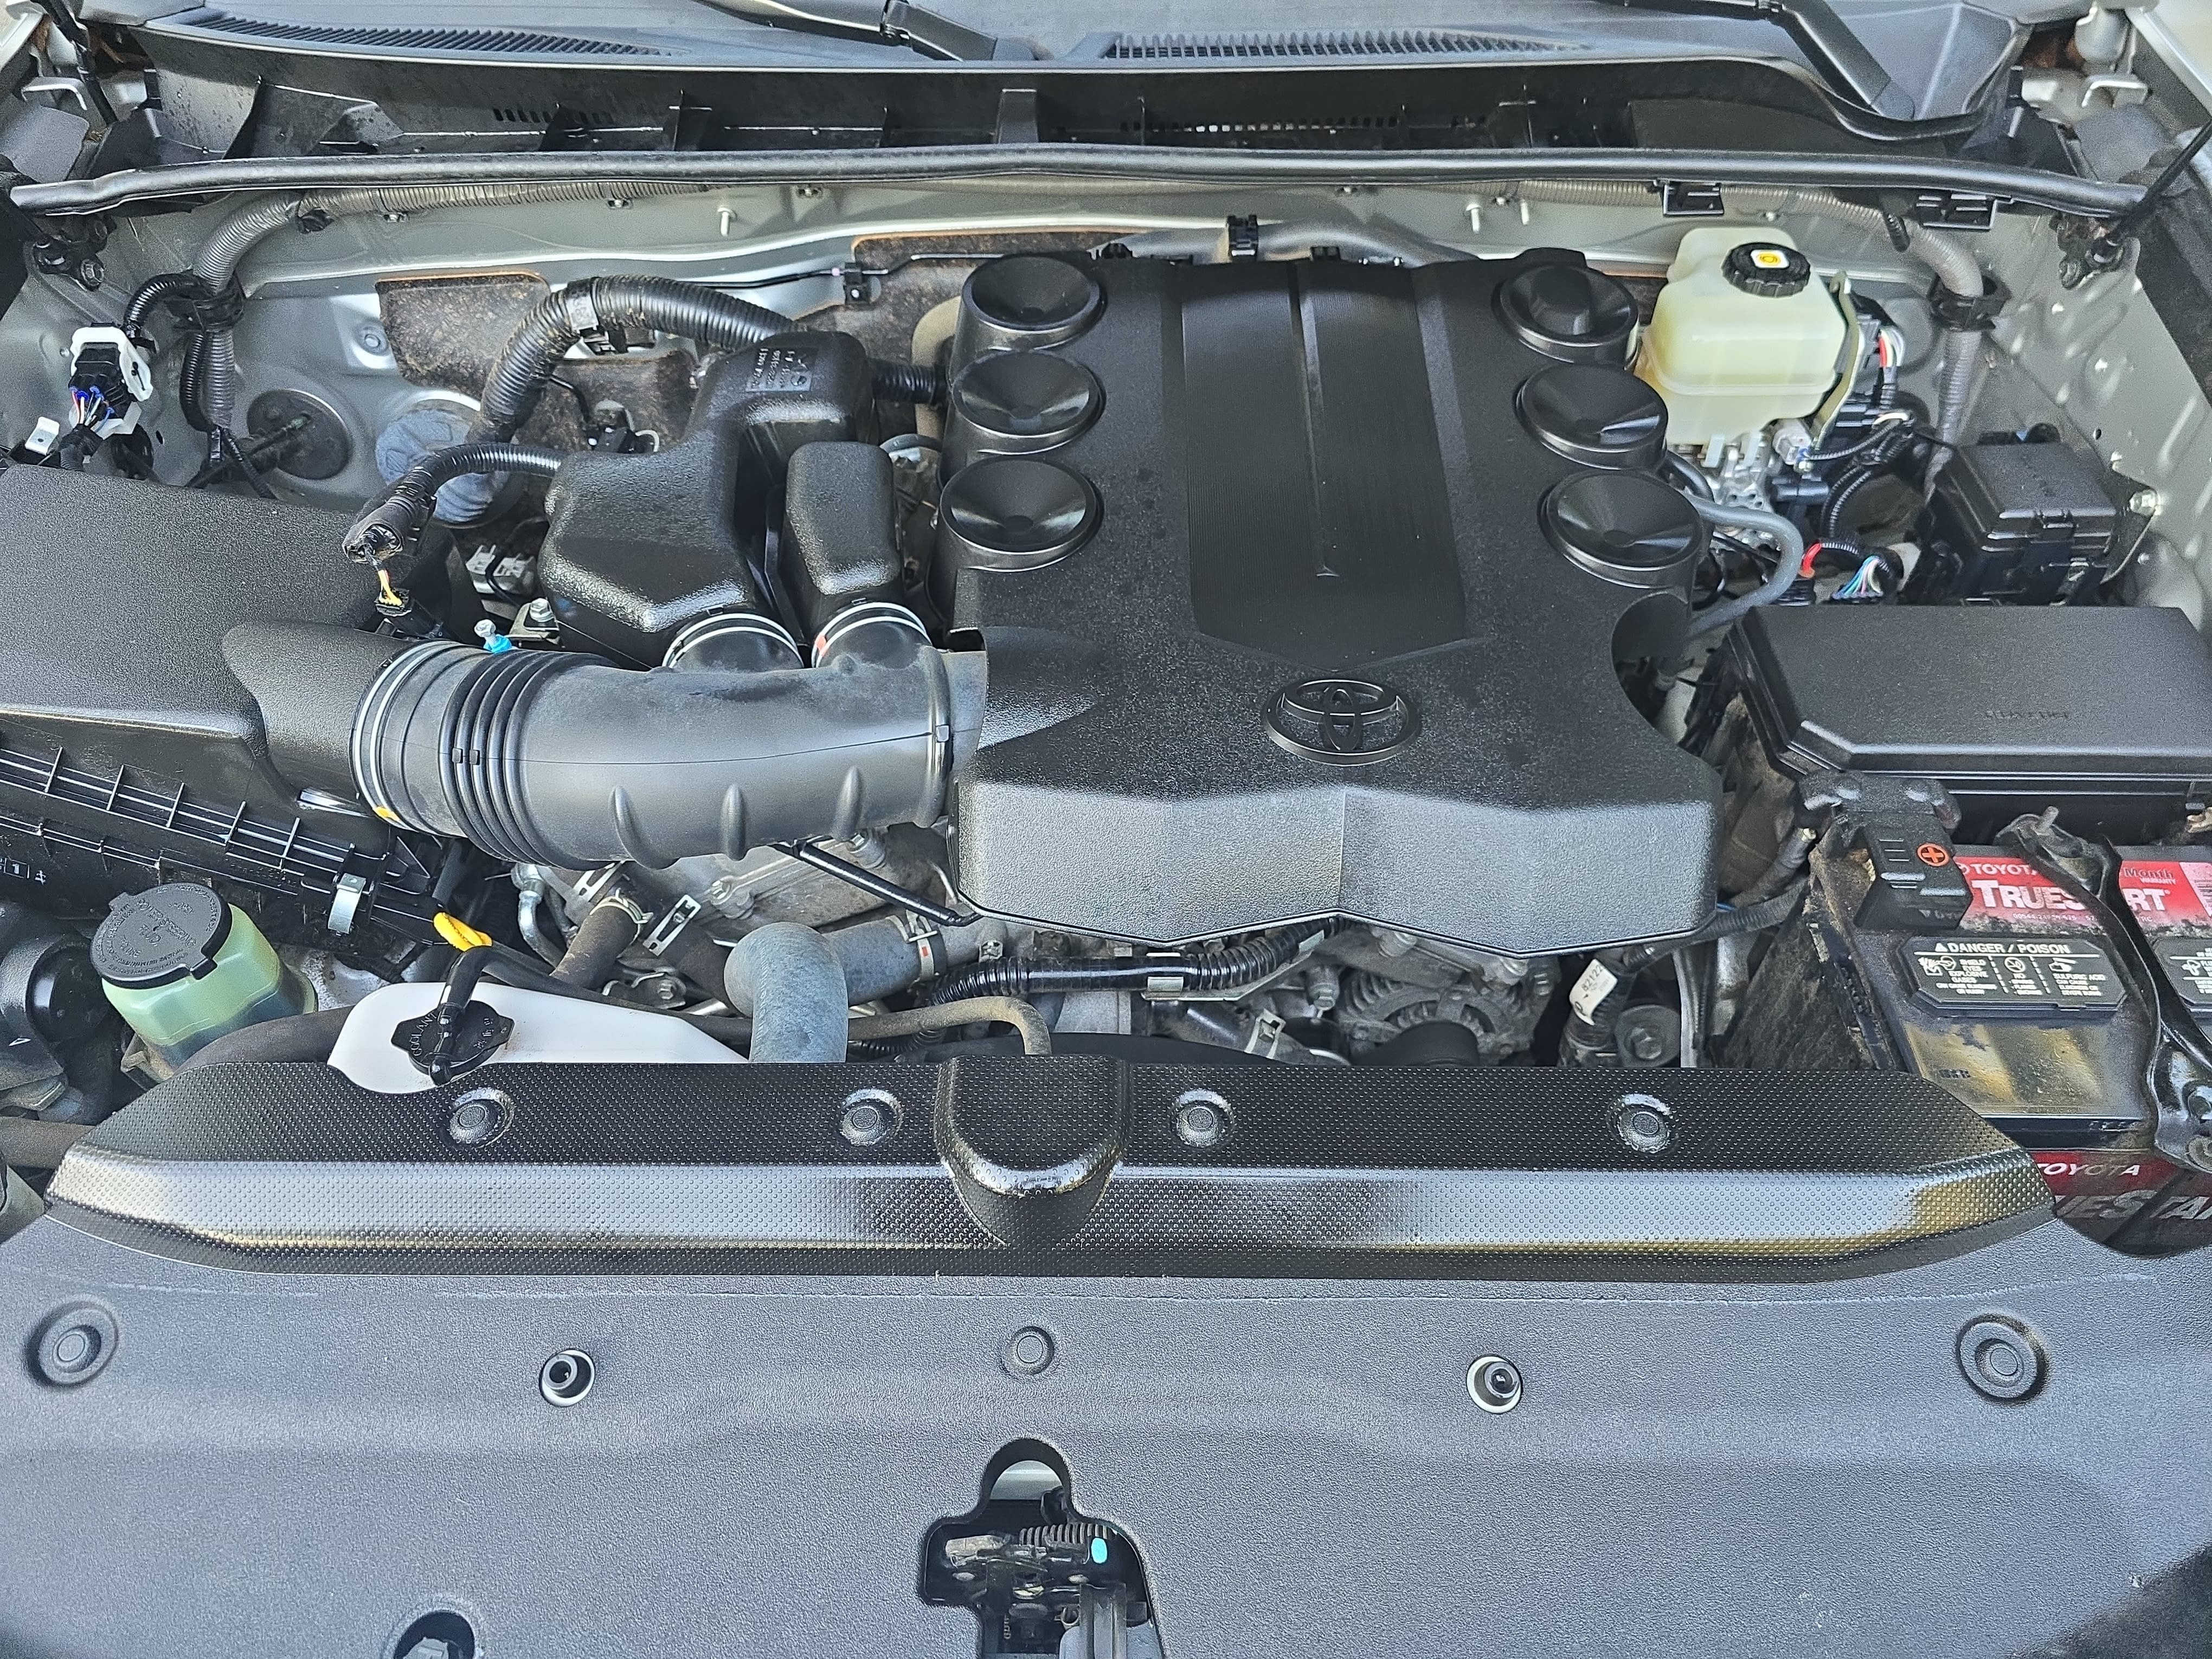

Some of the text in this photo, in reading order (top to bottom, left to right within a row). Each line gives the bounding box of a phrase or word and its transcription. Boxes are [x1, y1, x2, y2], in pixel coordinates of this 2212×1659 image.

[2124, 867, 2173, 878] Month
[1947, 943, 2006, 953] DANGER
[2017, 944, 2071, 954] POISON
[409, 1012, 437, 1056] COOLANT
